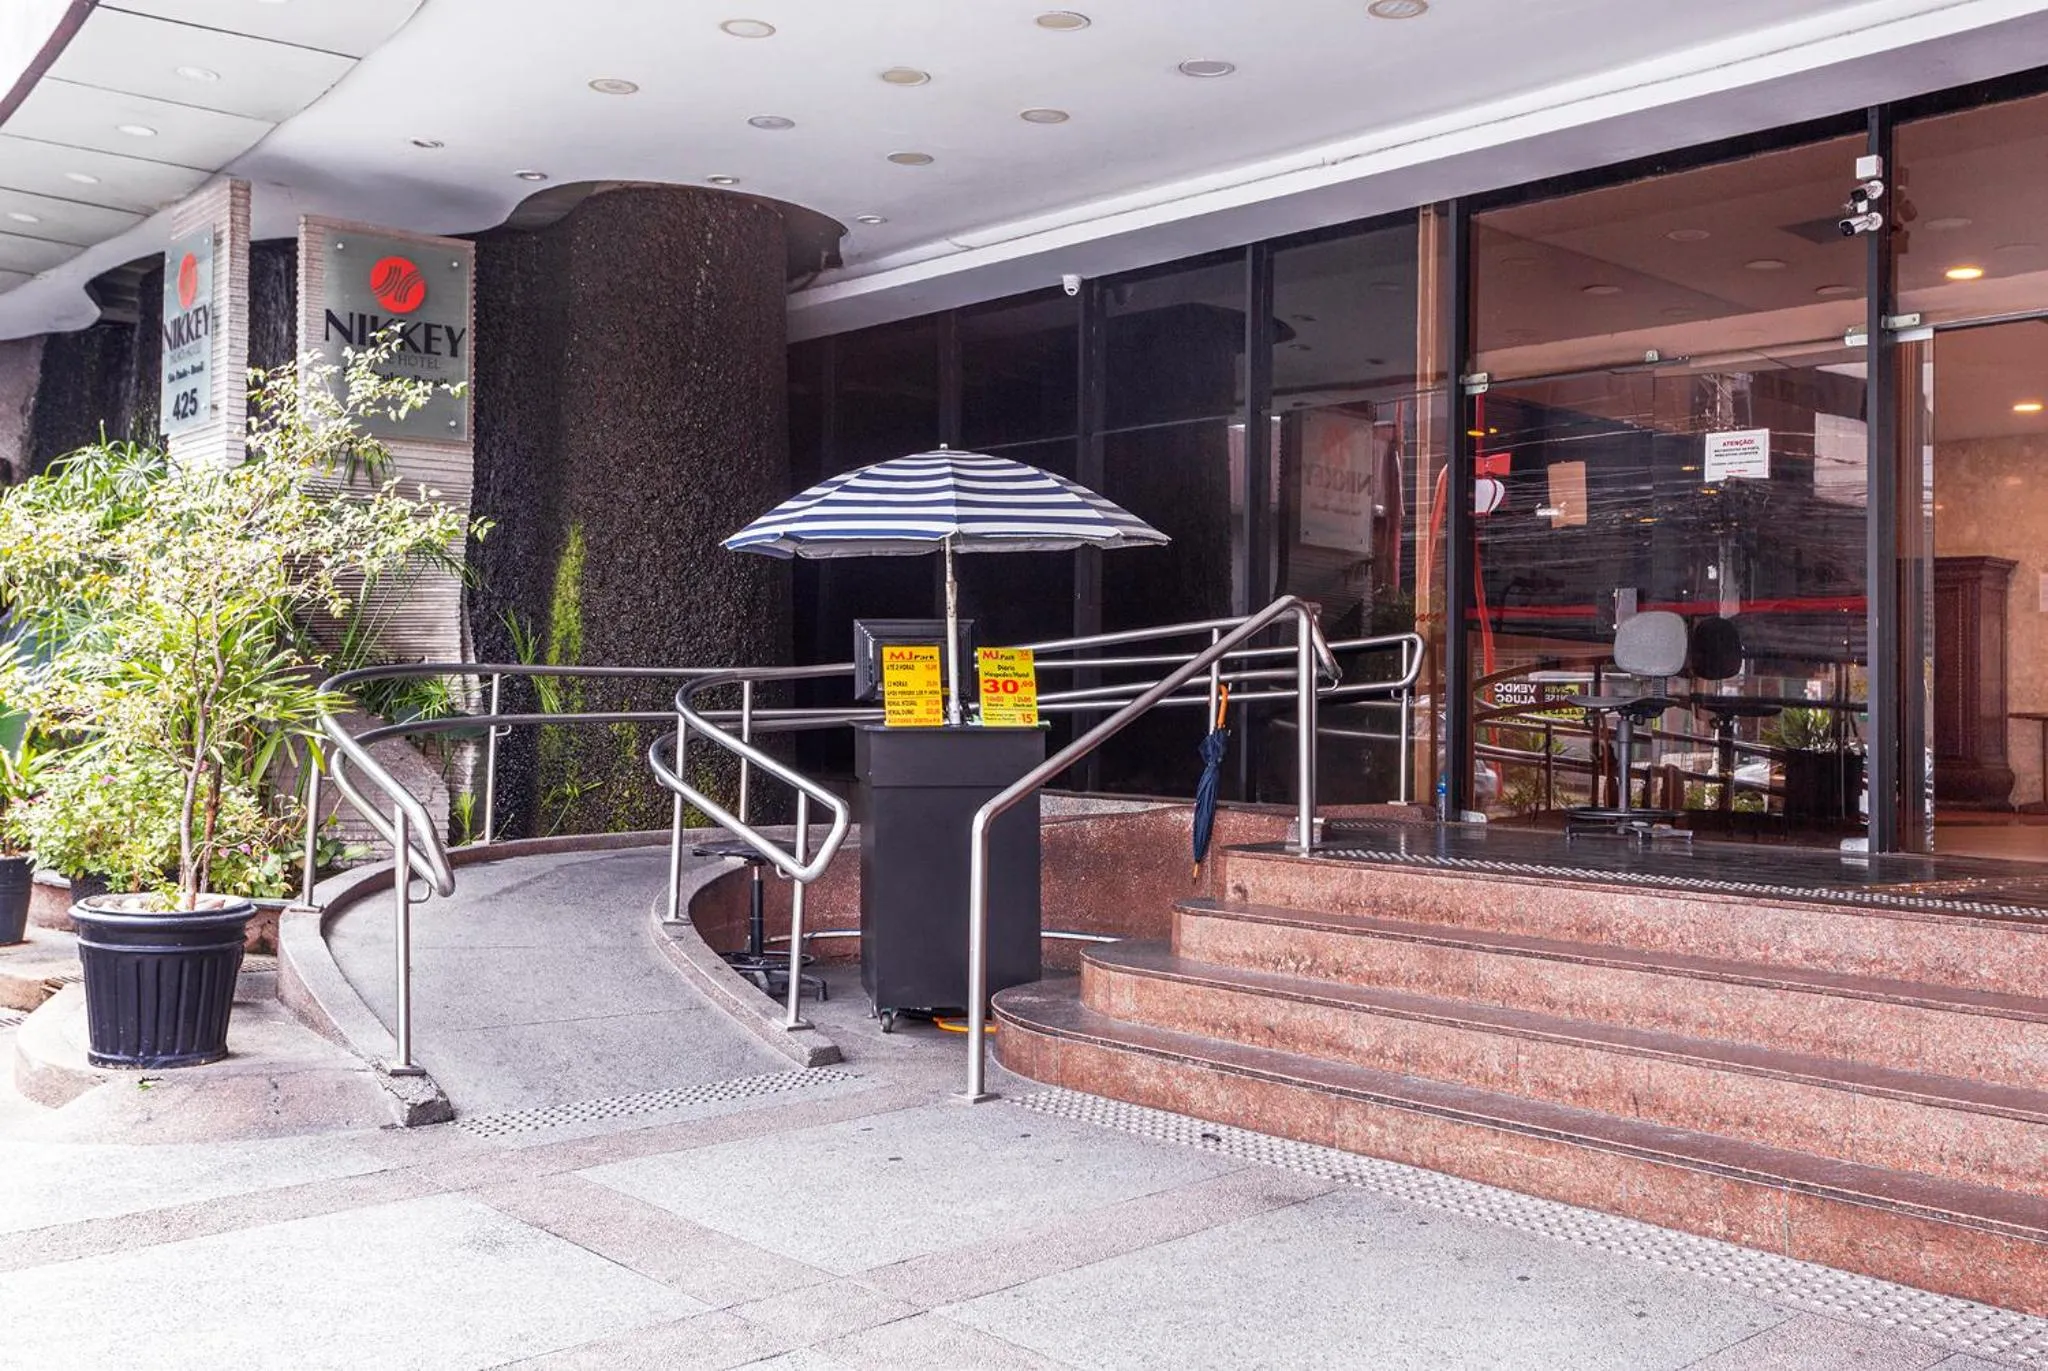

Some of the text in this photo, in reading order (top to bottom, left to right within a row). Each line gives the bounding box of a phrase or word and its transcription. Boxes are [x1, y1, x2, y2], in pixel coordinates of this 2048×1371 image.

[163, 303, 213, 351] NIKKEY
[324, 308, 467, 358] NIKKEY
[398, 354, 441, 370] HOTEL
[172, 387, 198, 421] 425
[890, 651, 913, 660] MJ
[983, 650, 1000, 660] MJ
